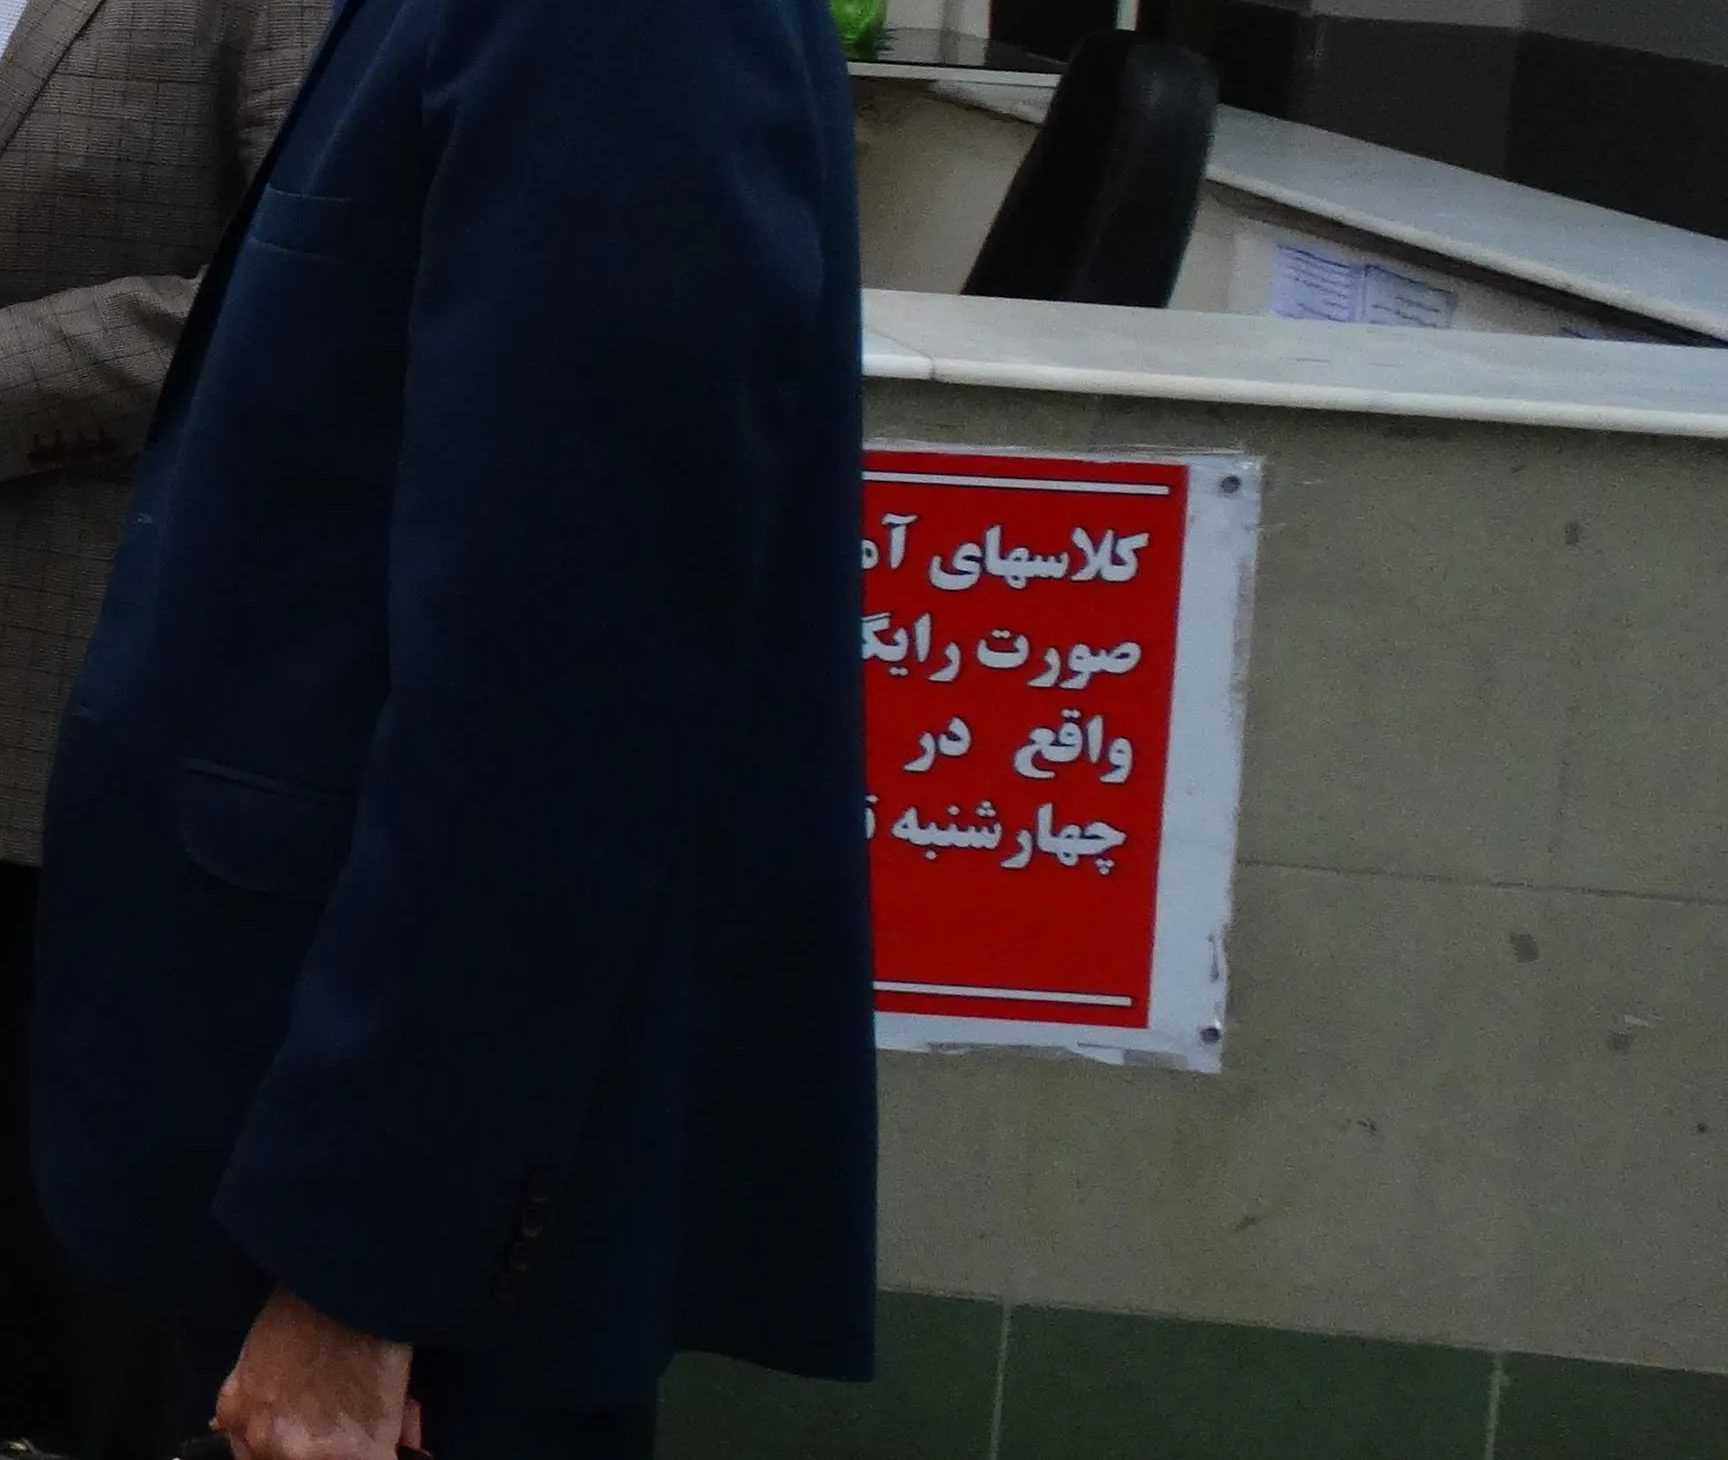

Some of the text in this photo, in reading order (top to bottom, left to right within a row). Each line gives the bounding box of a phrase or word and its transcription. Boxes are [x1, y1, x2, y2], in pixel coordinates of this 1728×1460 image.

[928, 524, 1150, 590] کلاسهای
[976, 628, 1142, 689] صورت
[902, 708, 1134, 784] واقع در
[890, 799, 1128, 876] چهارشنبه
